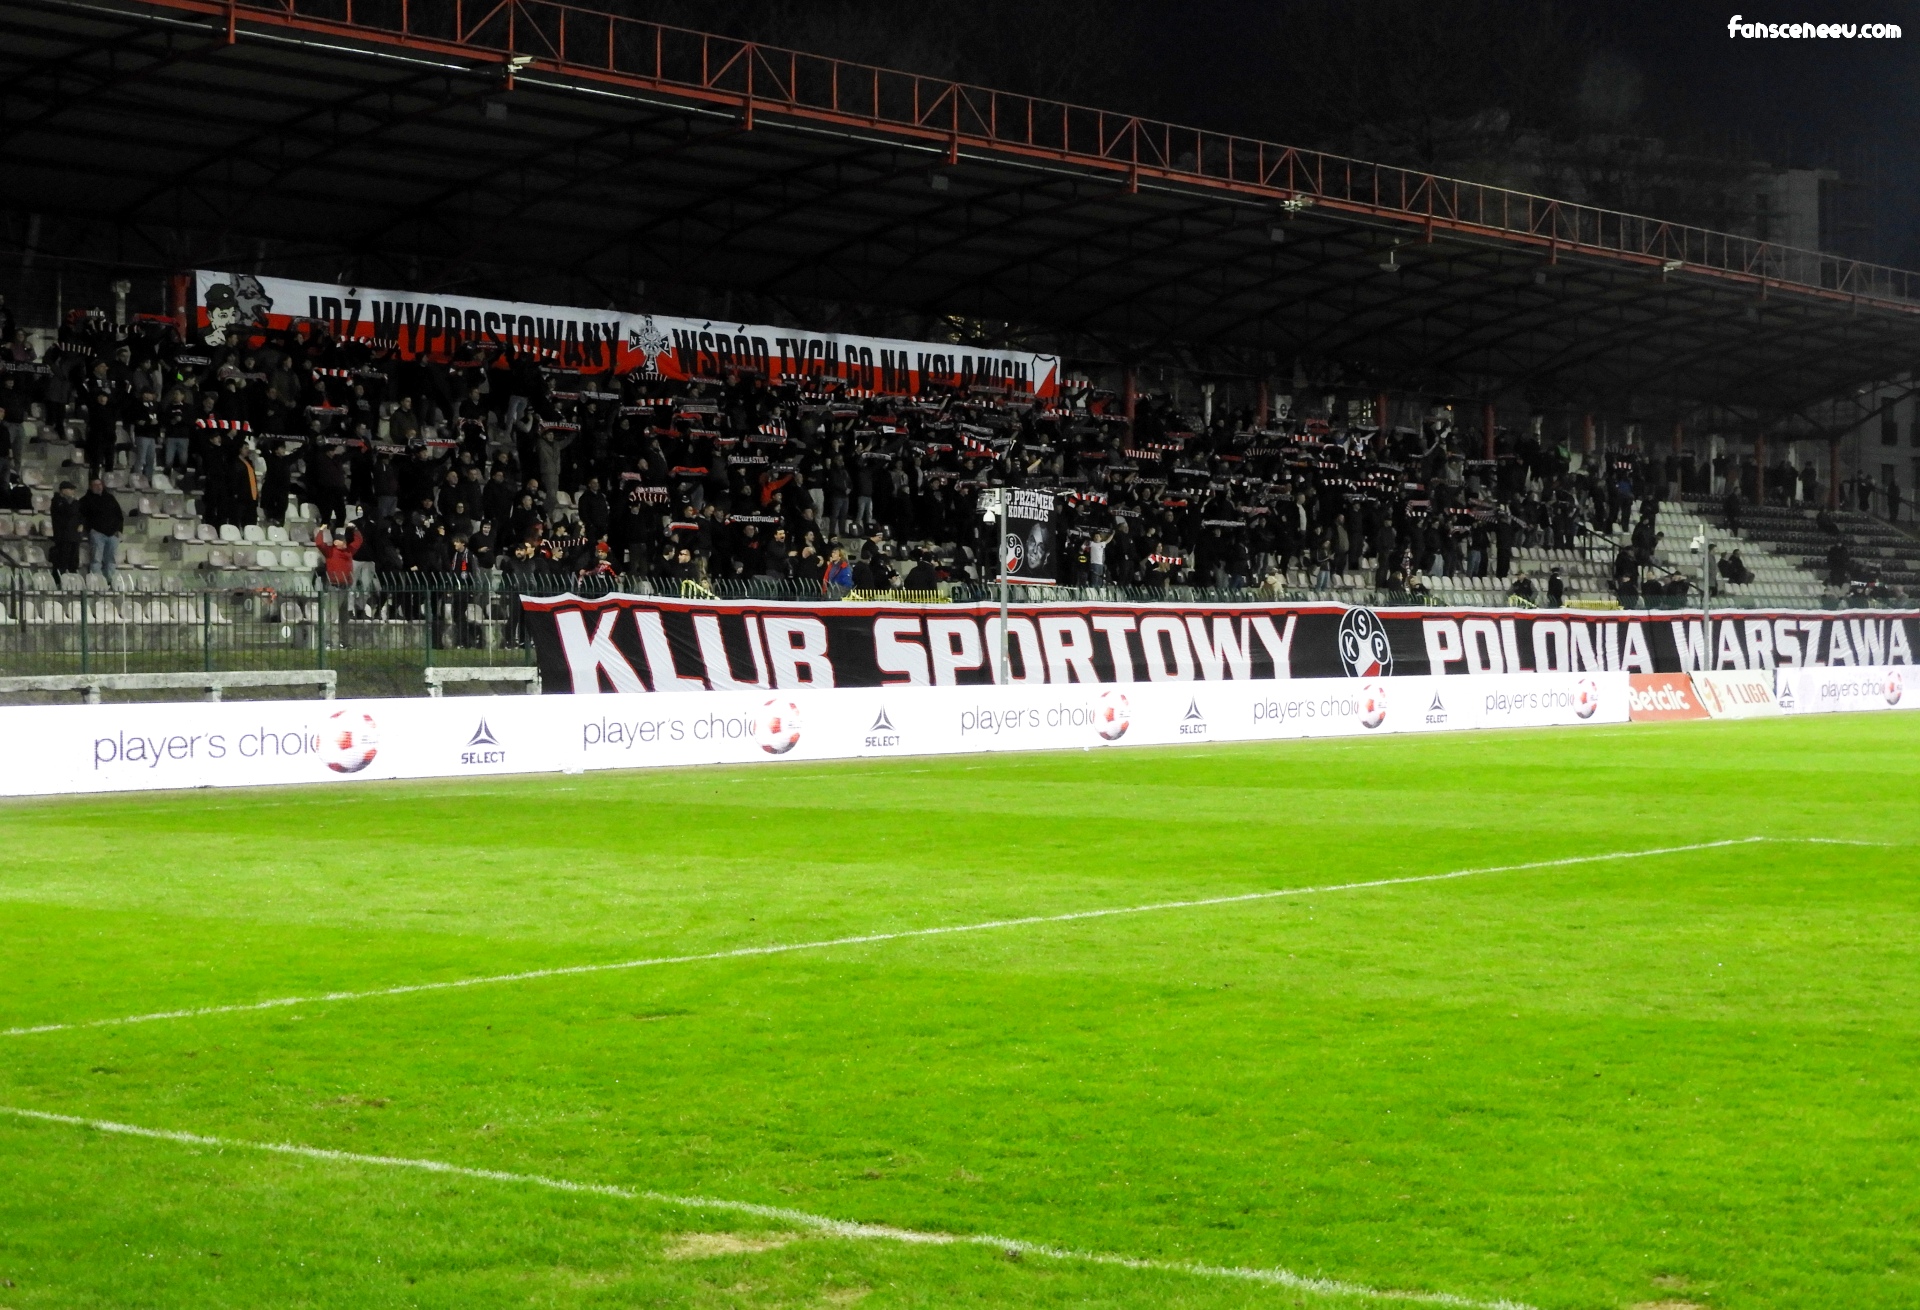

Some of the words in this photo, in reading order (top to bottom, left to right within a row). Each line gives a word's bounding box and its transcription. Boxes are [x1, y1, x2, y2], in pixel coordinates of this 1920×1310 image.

[309, 287, 361, 338] IDŹ
[372, 299, 620, 370] WYPROSTOWANY
[672, 321, 769, 376] WŚRÓD
[776, 338, 838, 378] TYCH
[845, 344, 874, 391] CO
[881, 348, 911, 394] NA
[1008, 505, 1049, 522] KOMANDOS
[1014, 490, 1055, 511] PRZEMEK
[554, 608, 835, 694] KLUB
[873, 612, 1298, 687] SPORTOWY
[1422, 616, 1655, 676] POLONIA
[1671, 617, 1912, 672] WARSZAWA
[1486, 690, 1538, 716] player's
[1629, 683, 1691, 711] Betclic
[1736, 683, 1770, 704] LIGA
[961, 705, 1040, 736] player's
[1254, 697, 1316, 725] player's
[1426, 714, 1448, 724] SELECT
[584, 716, 685, 751] player's
[865, 736, 900, 747] SELECT
[1180, 724, 1207, 734] SELECT
[95, 730, 226, 770] player's
[461, 751, 505, 764] SELECT
